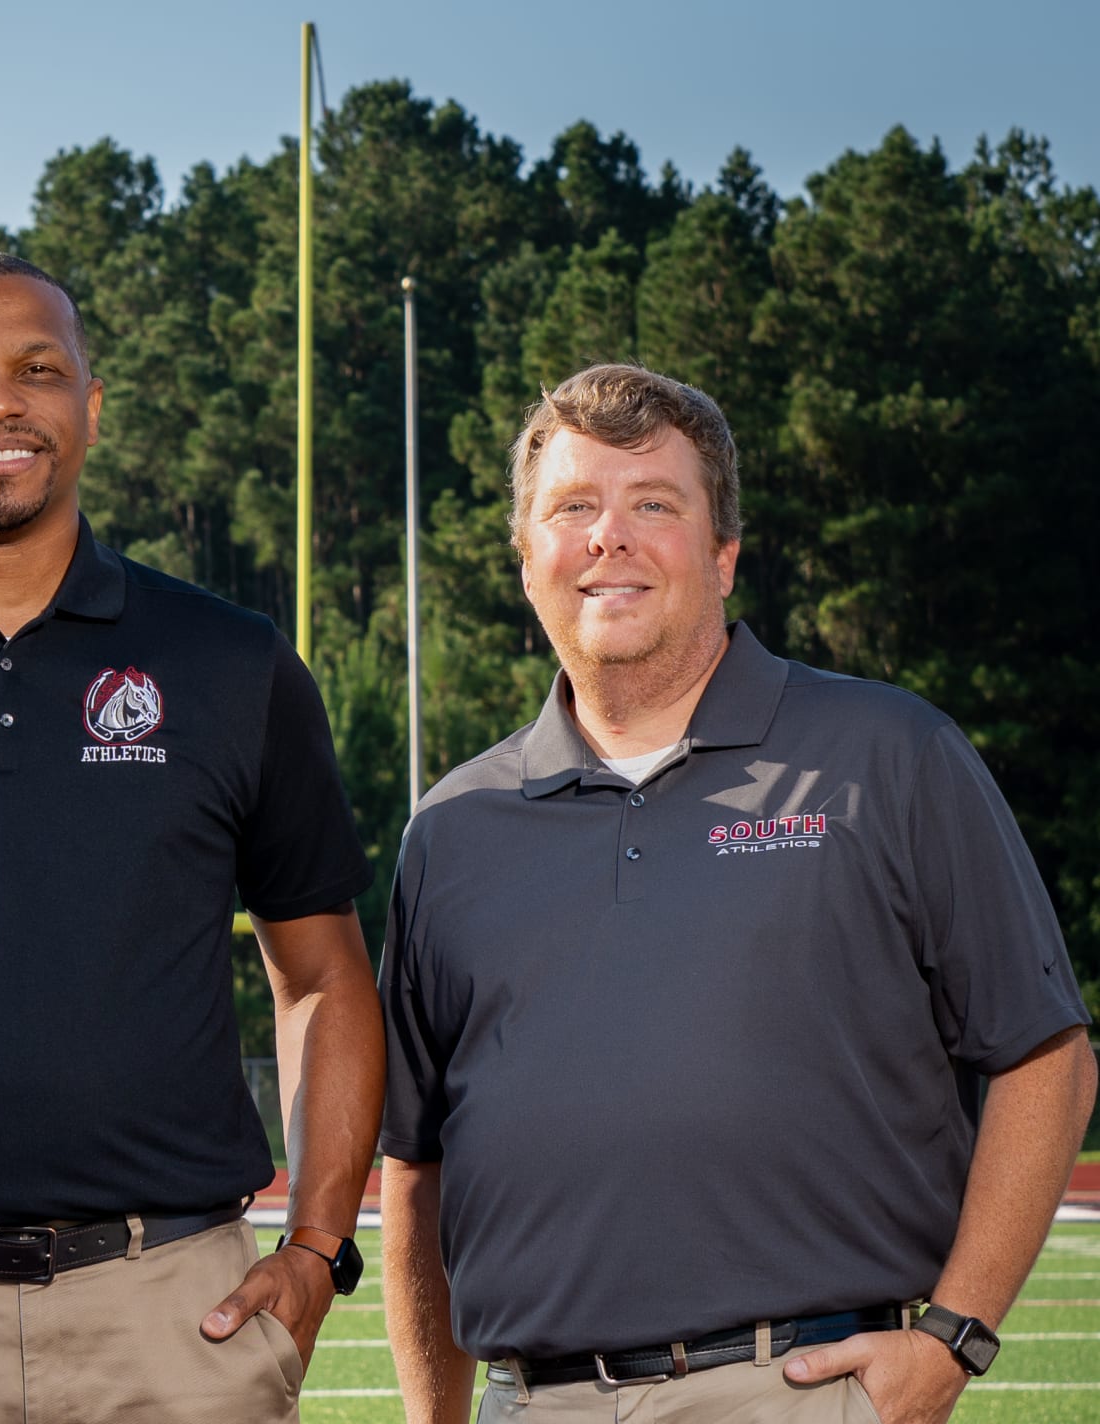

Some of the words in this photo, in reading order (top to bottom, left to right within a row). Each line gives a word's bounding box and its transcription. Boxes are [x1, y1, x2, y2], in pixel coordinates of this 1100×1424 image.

[81, 745, 166, 763] ATHLETICS
[708, 814, 826, 843] SOUTH
[716, 840, 820, 856] ATHLETICS
